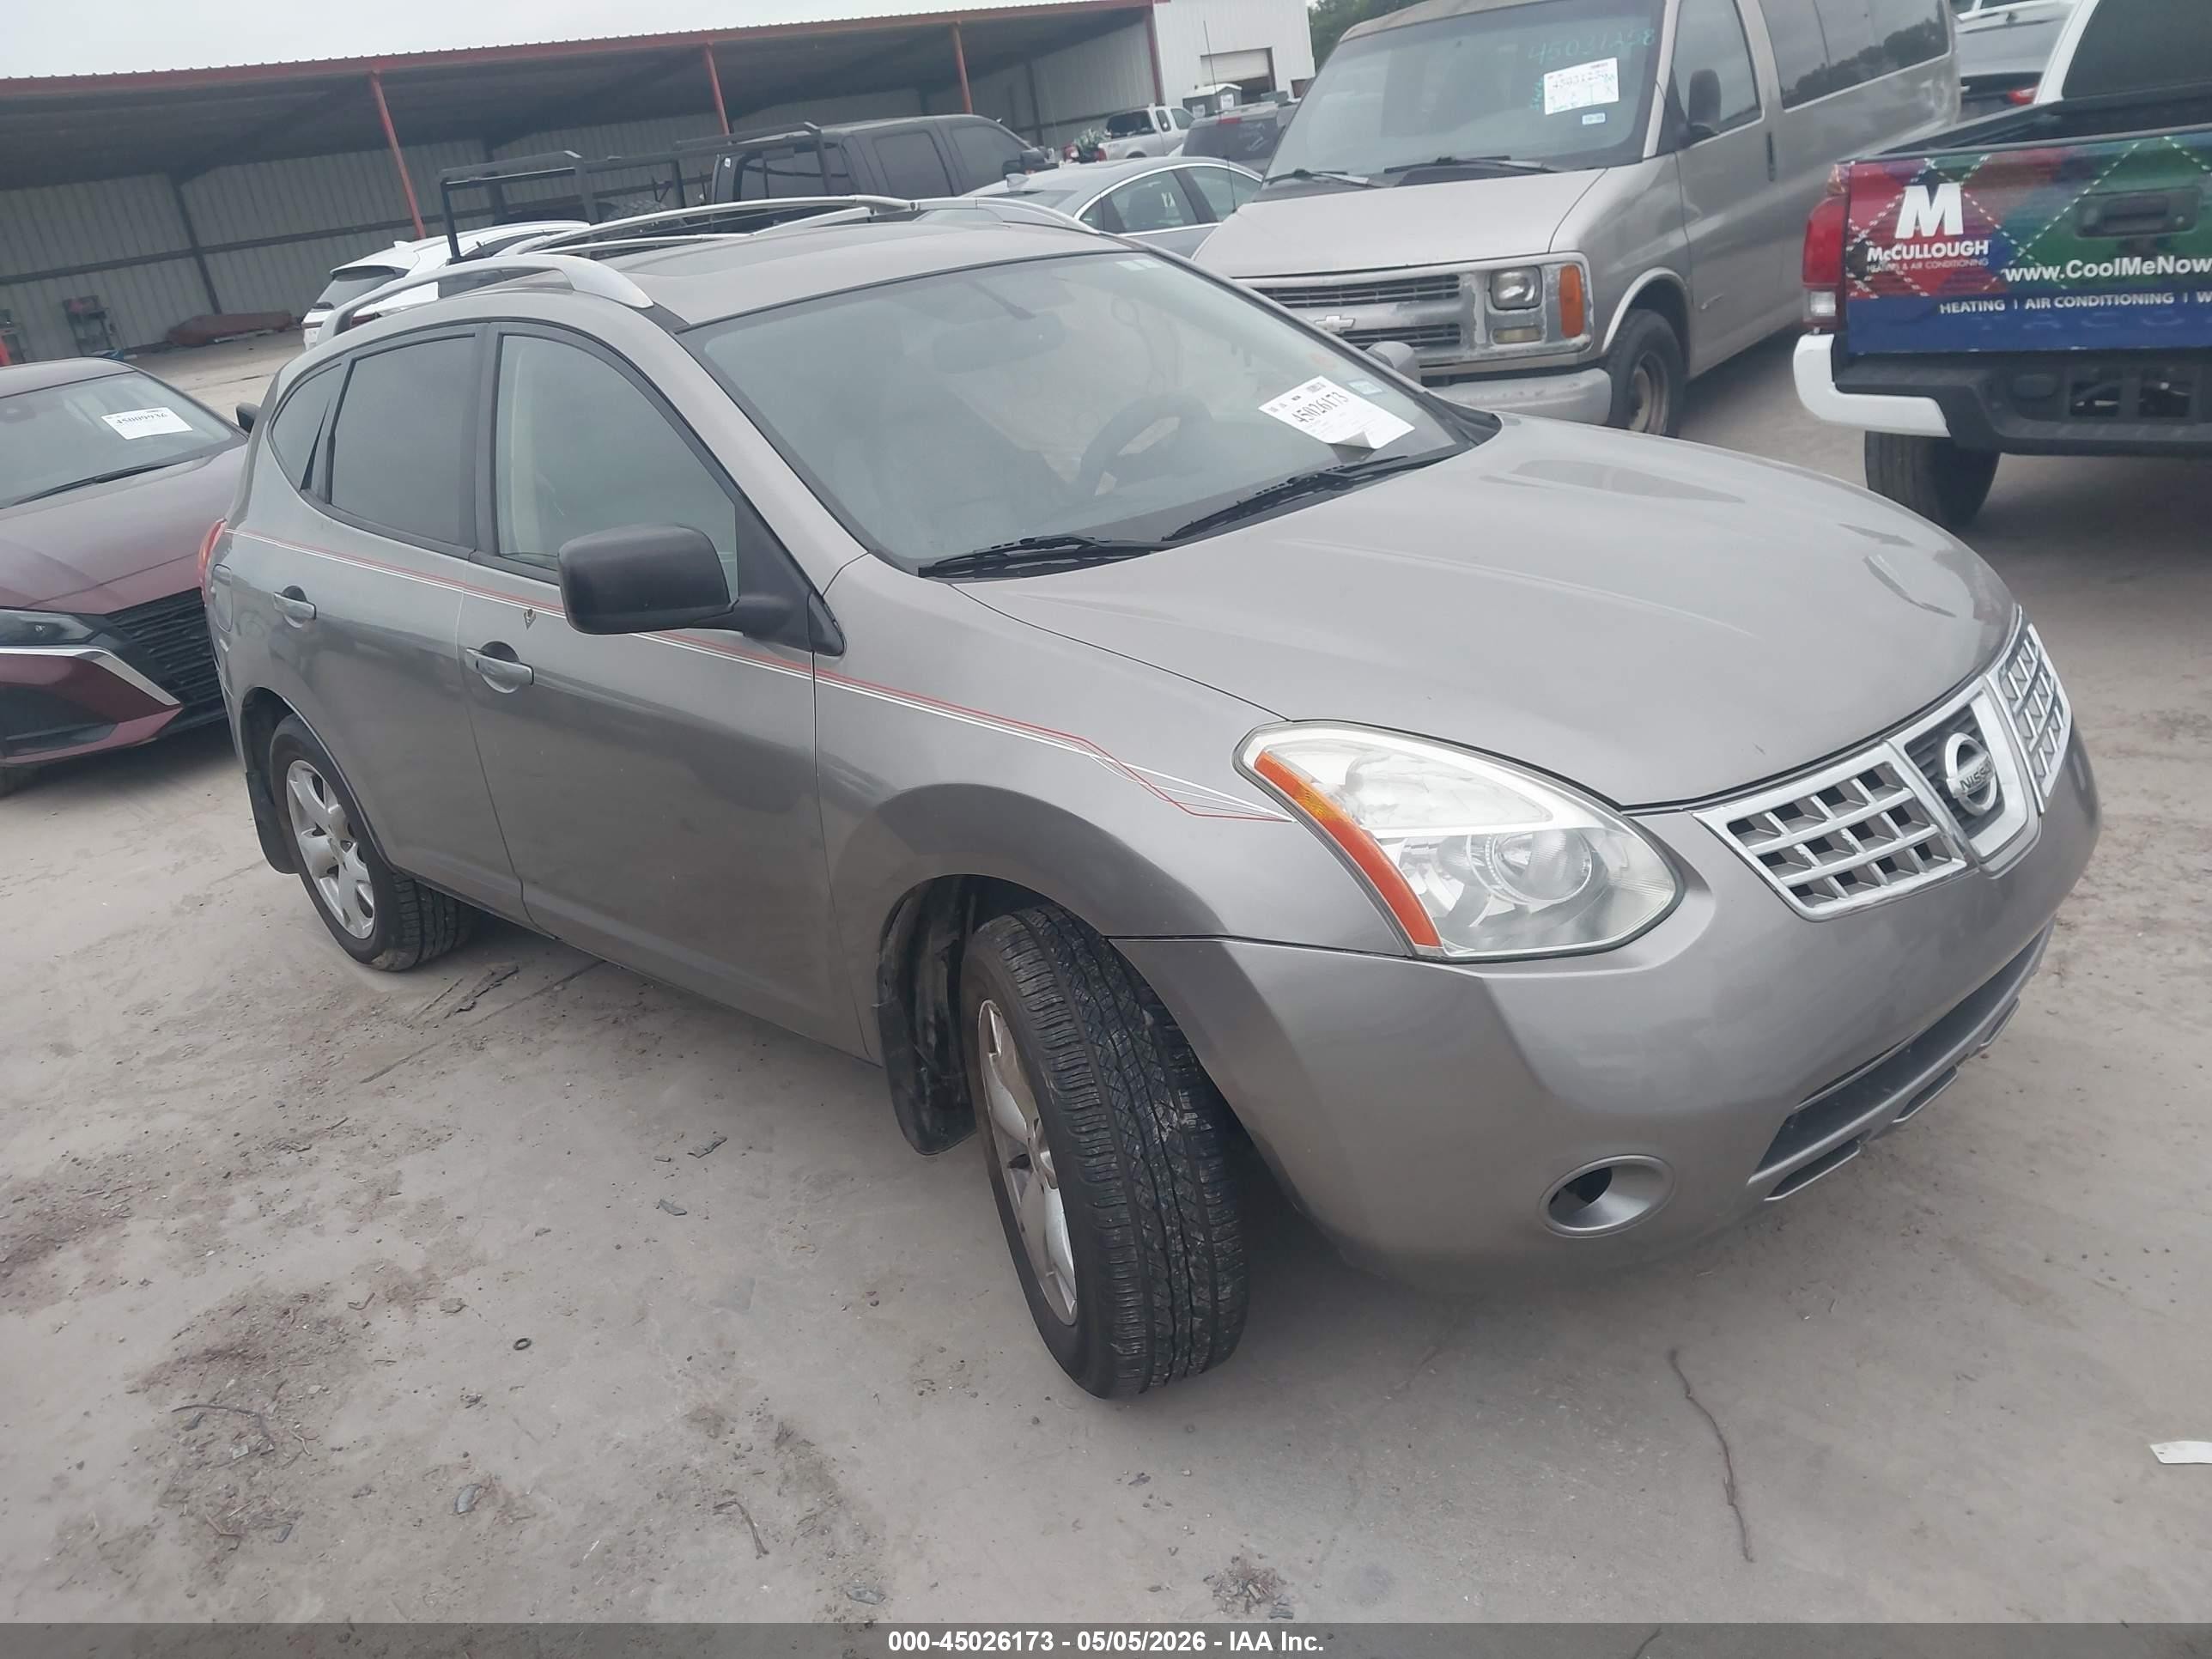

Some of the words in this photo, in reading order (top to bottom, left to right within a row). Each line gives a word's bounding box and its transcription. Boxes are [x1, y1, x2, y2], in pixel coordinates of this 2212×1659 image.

[1895, 183, 1964, 239] M
[1867, 240, 1989, 261] McCULLOUGH
[1940, 300, 2005, 313] HEATING
[2025, 297, 2051, 310] AIR
[2054, 293, 2174, 307] CONDITIONING
[1291, 391, 1348, 422] 45026173
